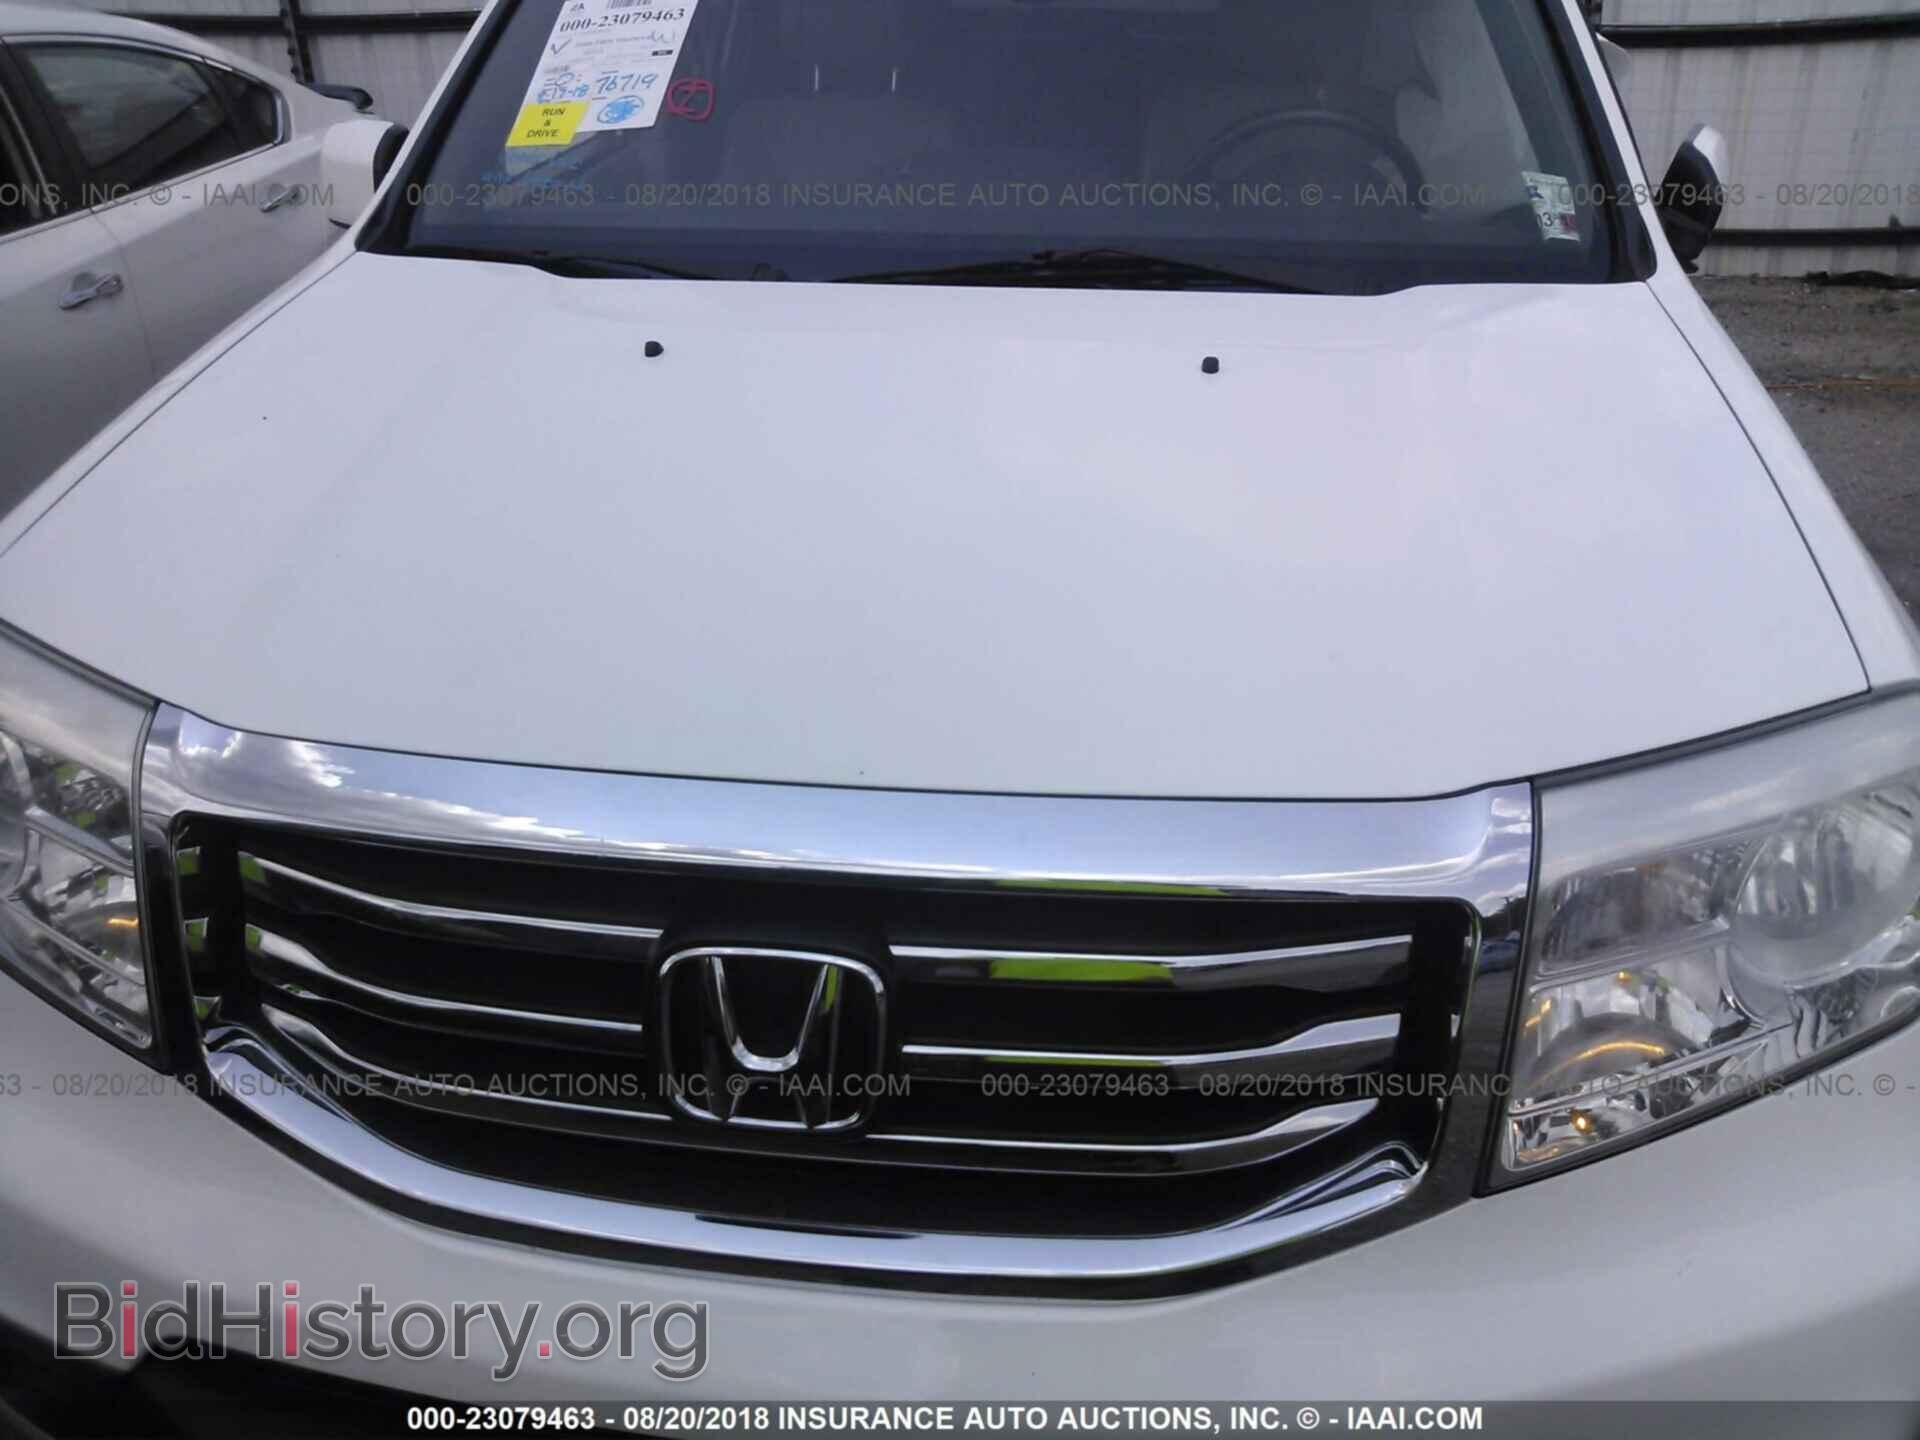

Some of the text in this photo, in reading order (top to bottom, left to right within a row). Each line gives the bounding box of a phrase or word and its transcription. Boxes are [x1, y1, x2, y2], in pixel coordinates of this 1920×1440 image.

[560, 8, 685, 32] 000-23079463
[541, 107, 567, 117] RUN
[526, 129, 560, 138] DRIVE
